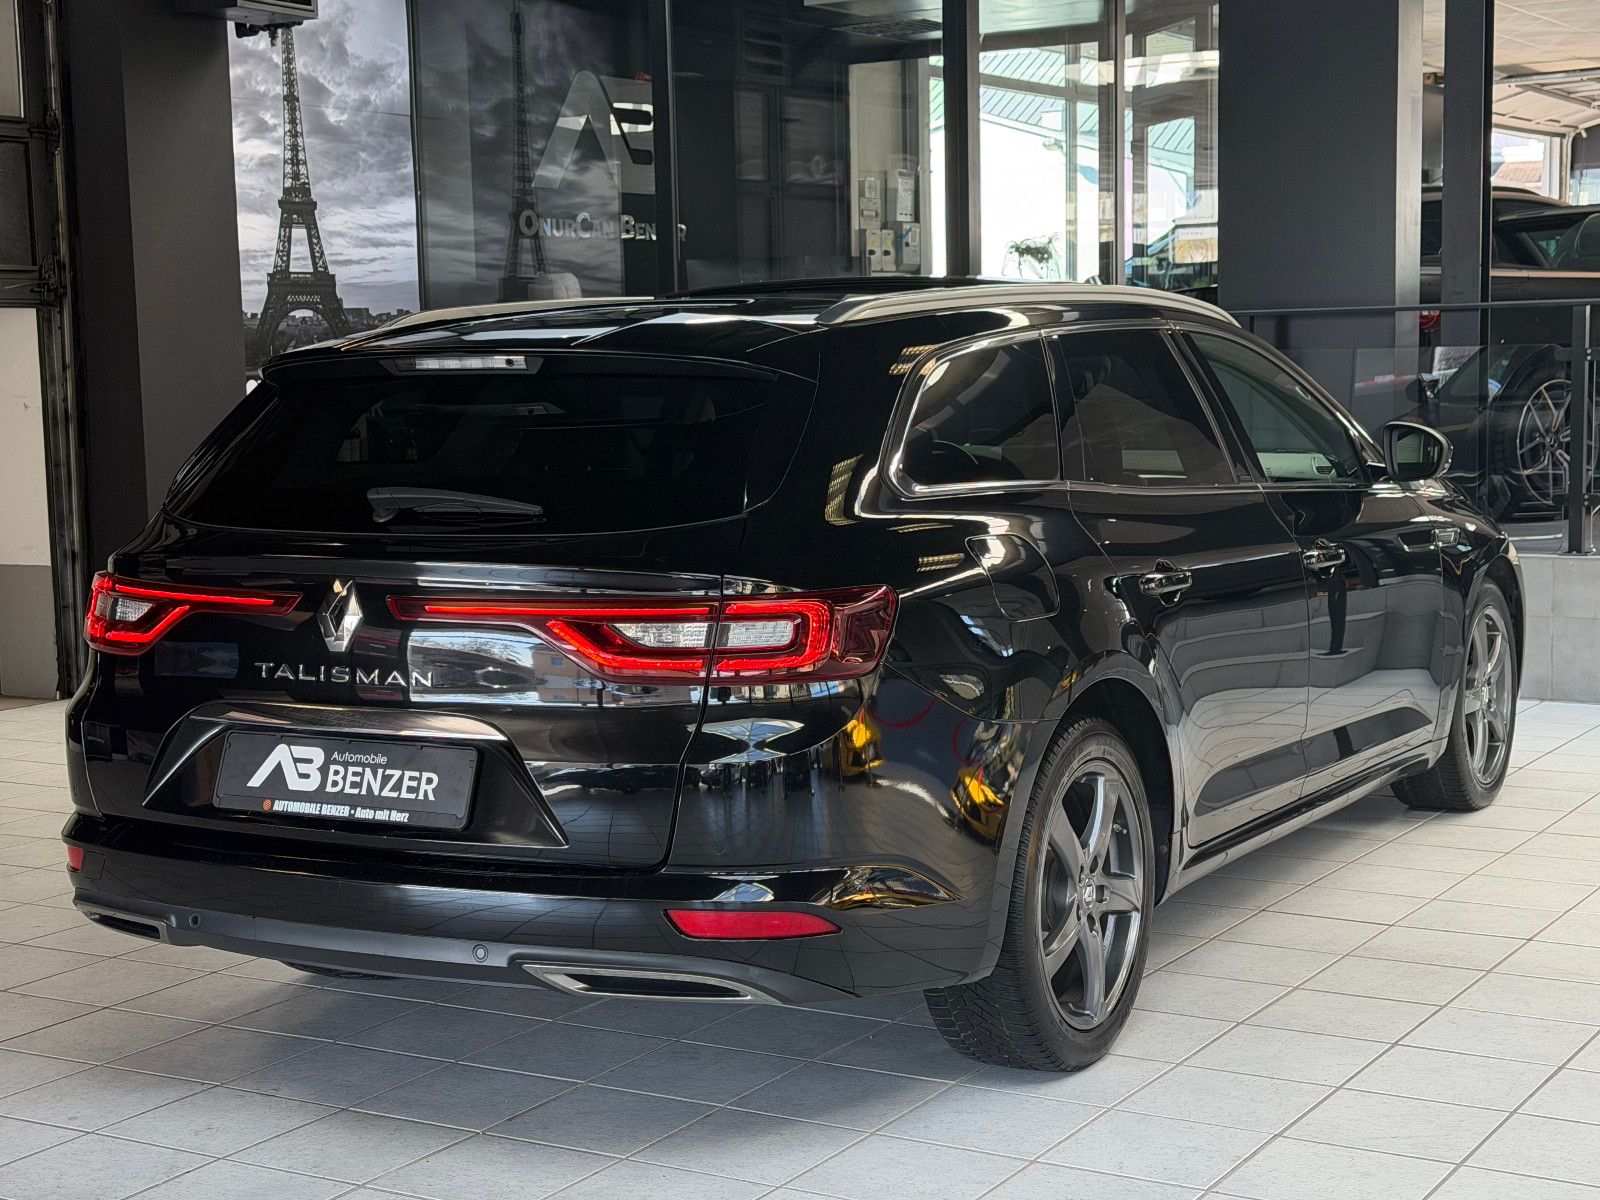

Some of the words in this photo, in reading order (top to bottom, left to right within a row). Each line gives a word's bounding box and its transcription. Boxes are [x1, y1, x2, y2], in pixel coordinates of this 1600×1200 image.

[254, 662, 434, 688] TALISMAN
[330, 751, 388, 765] Automobile
[325, 764, 439, 801] BENZER
[272, 800, 321, 814] AUTOMOBILE
[320, 803, 350, 817] BENZER
[355, 807, 375, 819] Auto
[375, 808, 390, 821] mit
[390, 810, 410, 823] Herz
